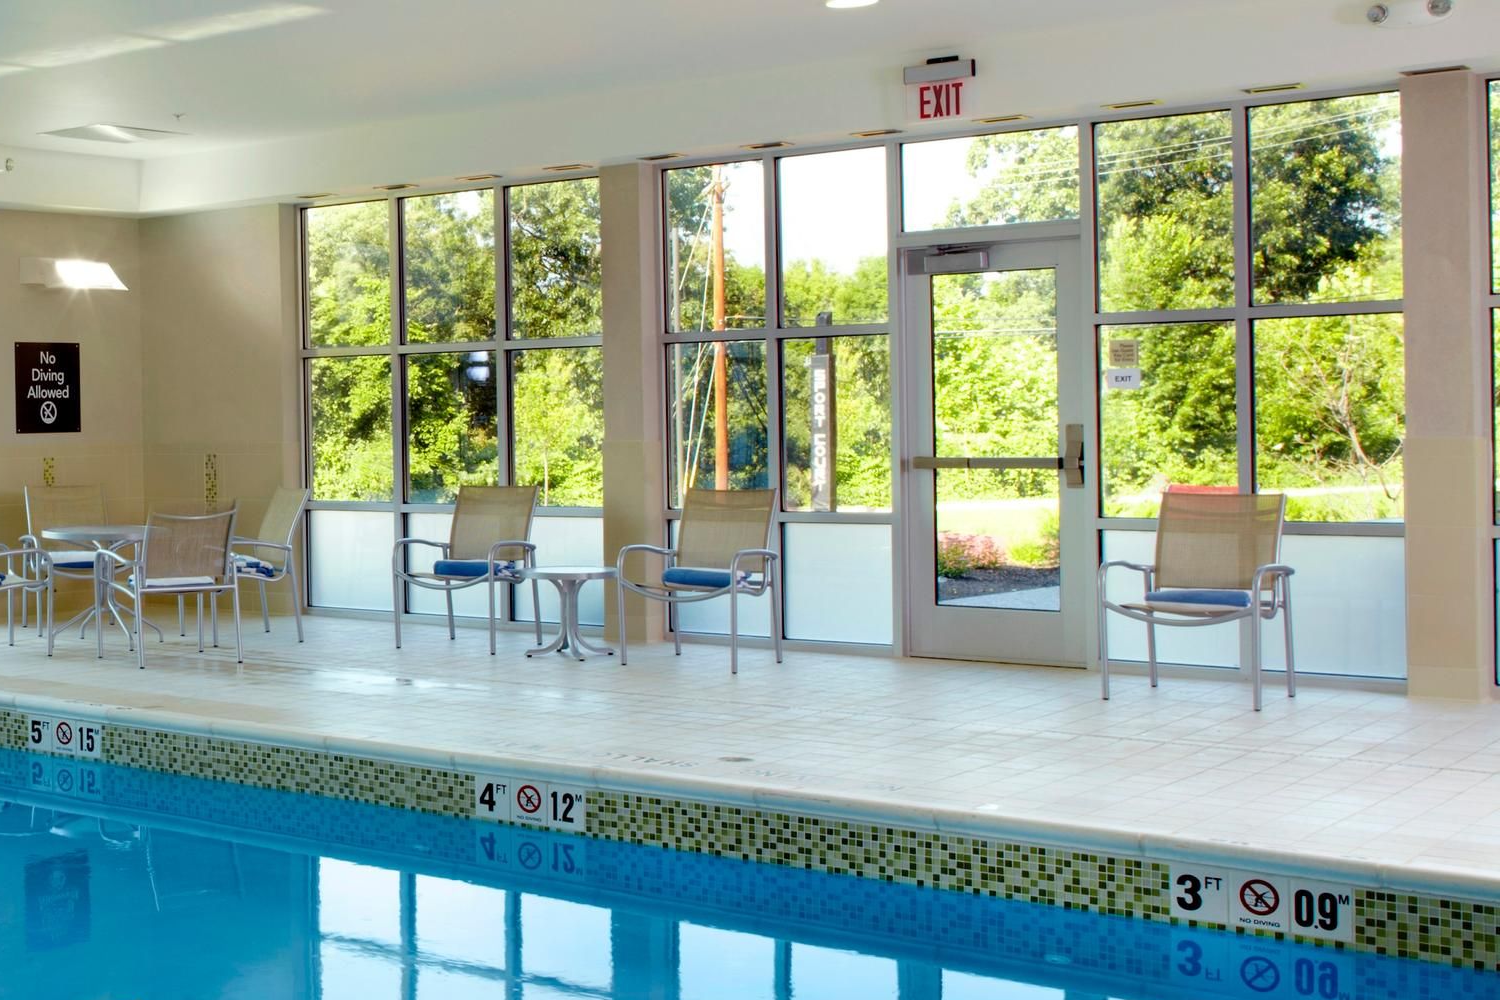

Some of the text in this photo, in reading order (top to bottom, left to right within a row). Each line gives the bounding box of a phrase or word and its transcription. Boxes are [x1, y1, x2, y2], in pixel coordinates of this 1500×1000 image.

[919, 82, 963, 119] EXIT
[40, 351, 56, 364] No
[31, 368, 65, 385] Diving
[27, 385, 69, 399] Allowed
[31, 720, 43, 744] 5
[479, 783, 496, 812] 4
[496, 784, 507, 794] FT
[1176, 874, 1203, 911] 3
[1204, 876, 1223, 891] FT
[1253, 920, 1281, 928] DIVING
